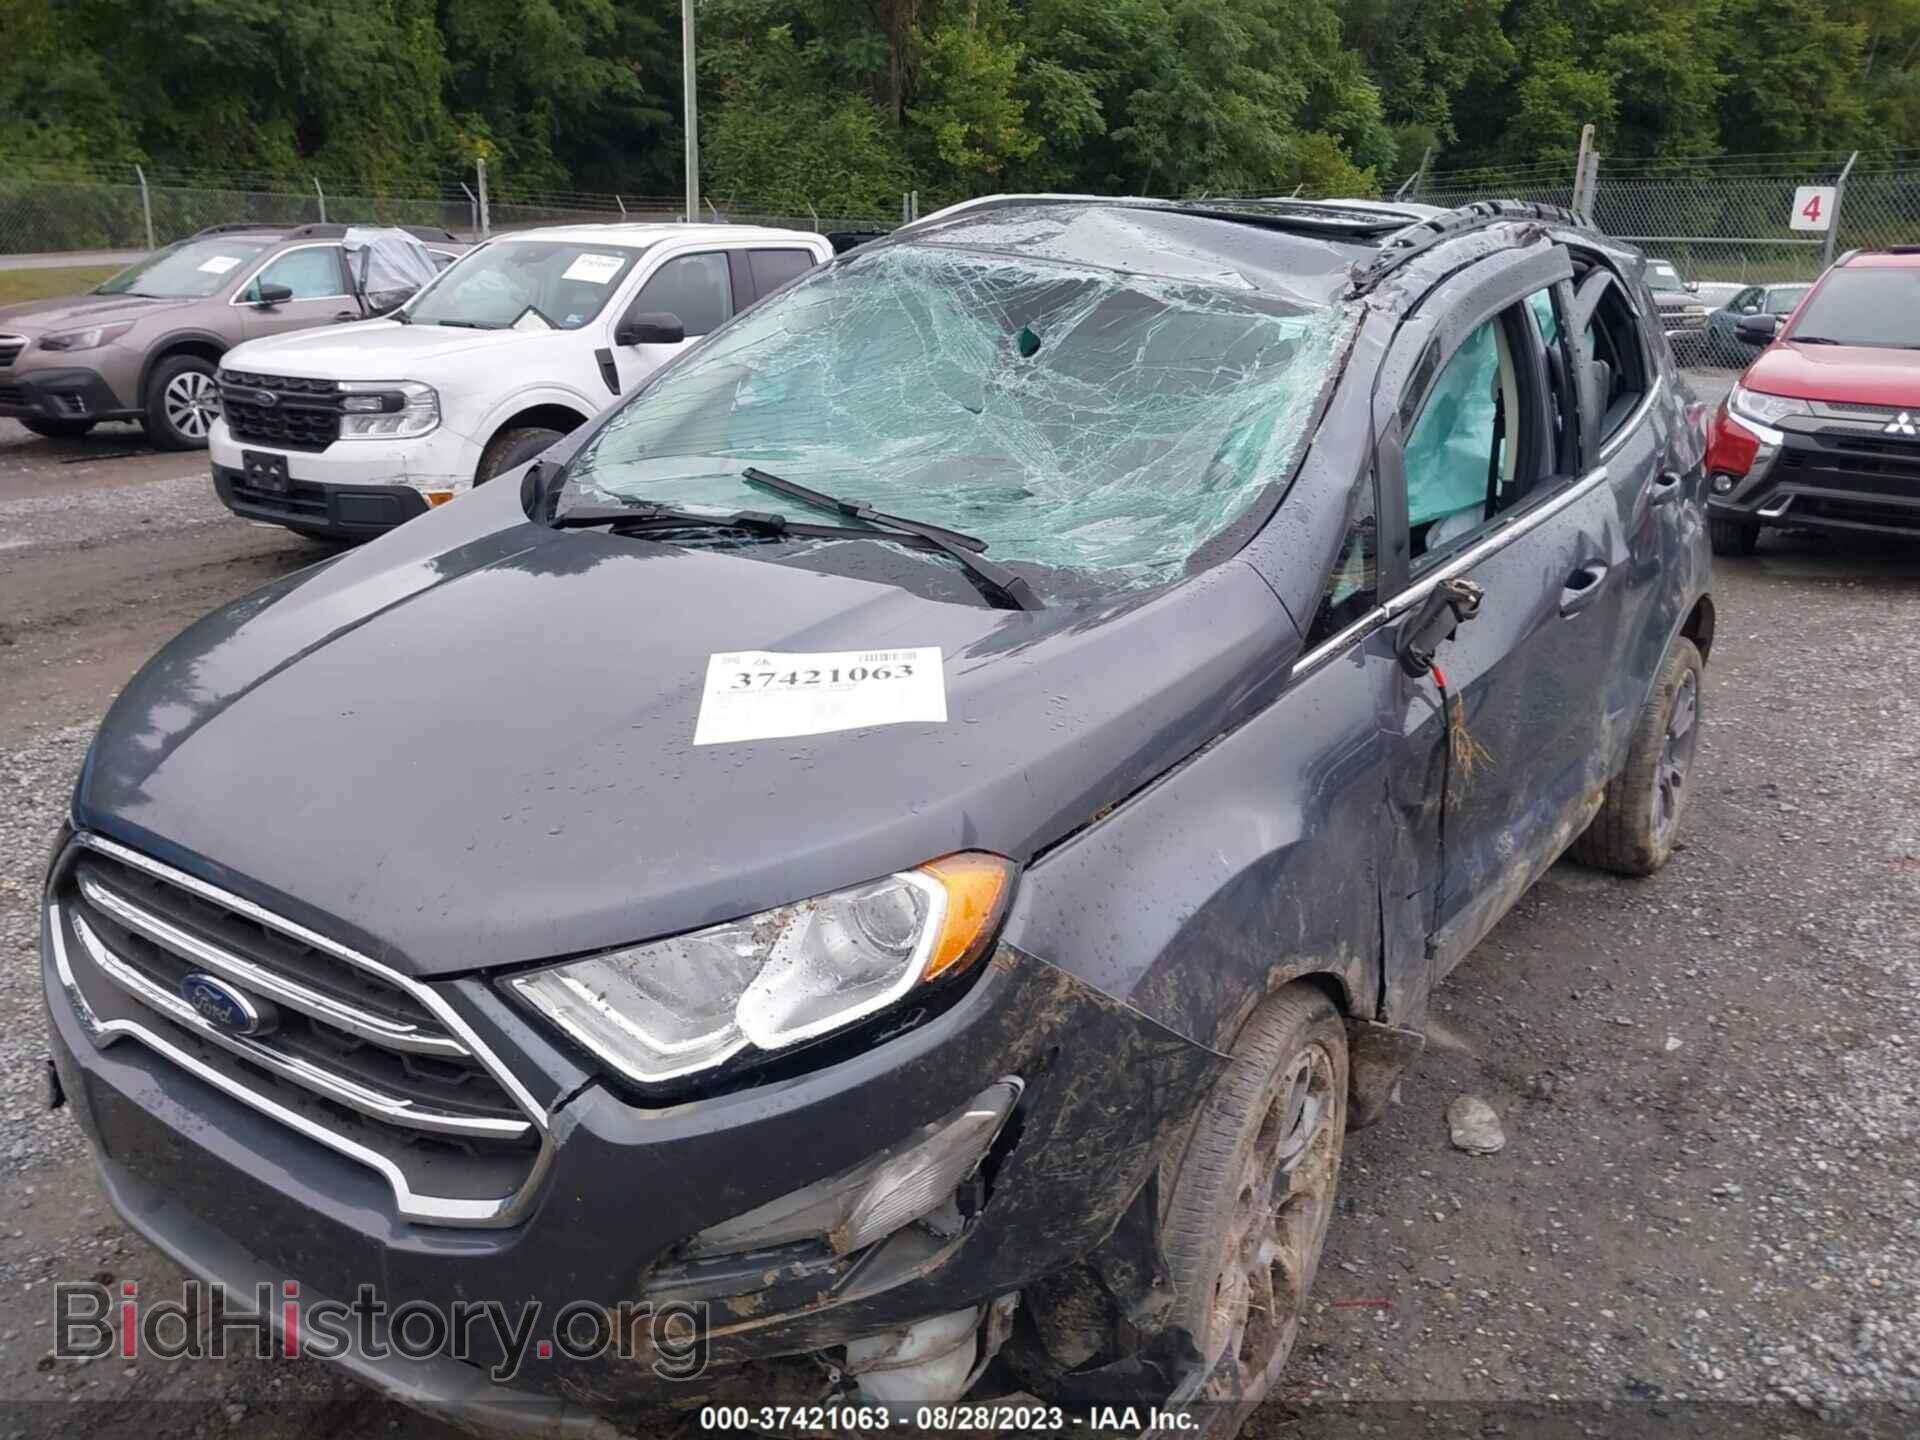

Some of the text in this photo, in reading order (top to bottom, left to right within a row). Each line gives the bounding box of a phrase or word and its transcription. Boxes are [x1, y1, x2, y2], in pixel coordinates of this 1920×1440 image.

[1802, 195, 1821, 222] 4
[733, 664, 914, 689] 37421063
[191, 984, 233, 1024] Ford
